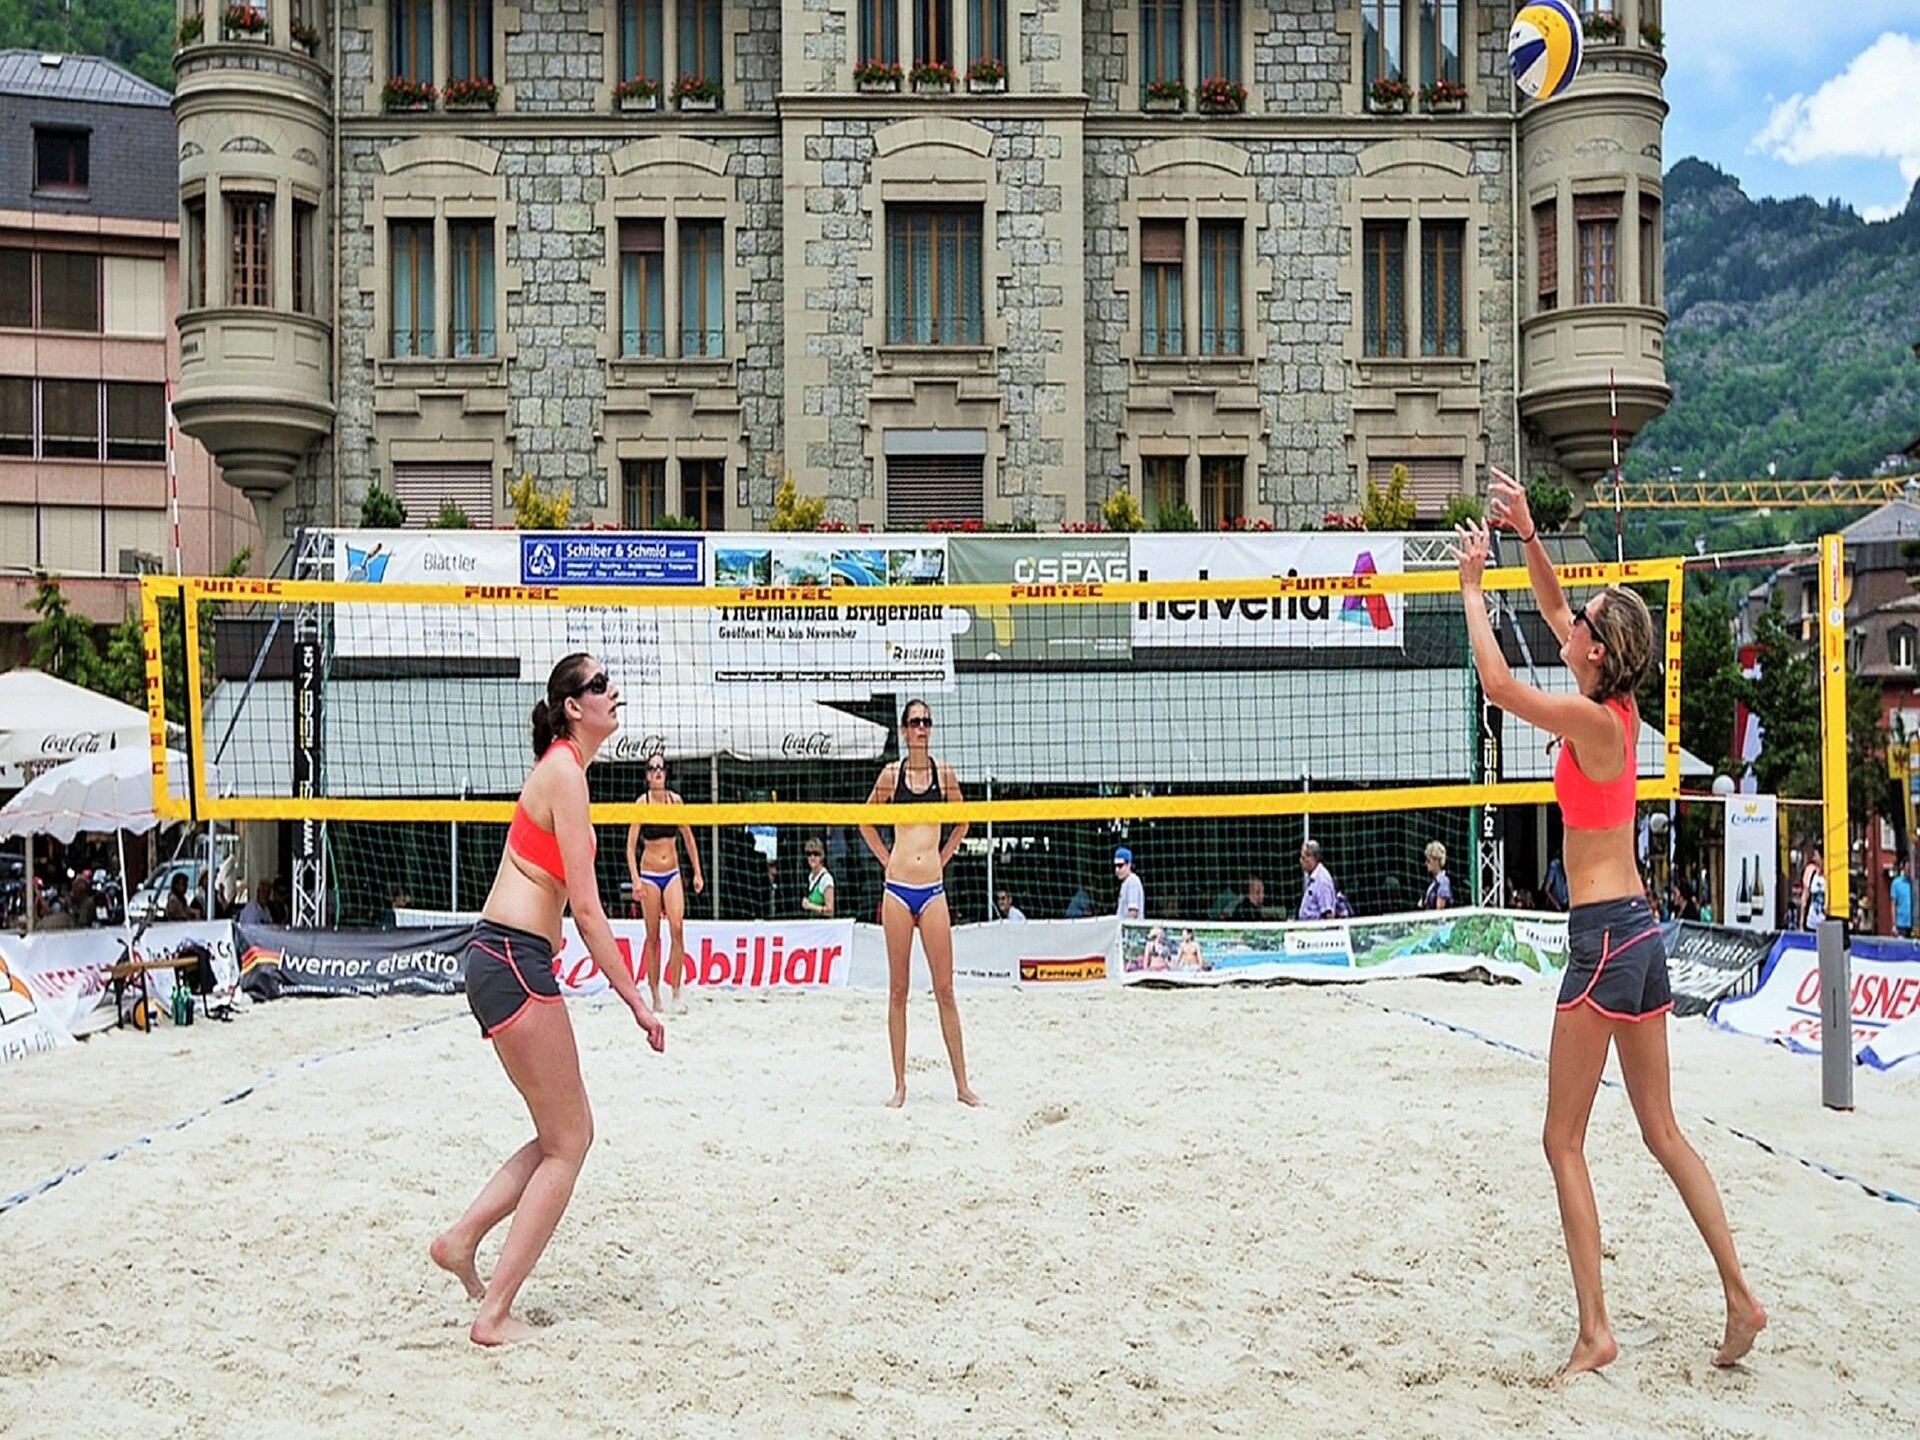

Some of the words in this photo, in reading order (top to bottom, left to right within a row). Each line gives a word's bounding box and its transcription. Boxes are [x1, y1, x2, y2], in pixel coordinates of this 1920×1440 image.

[567, 544, 612, 557] Schriber
[615, 544, 624, 557] &
[627, 544, 667, 558] Schmid
[806, 627, 857, 640] November
[376, 949, 458, 976] elektro
